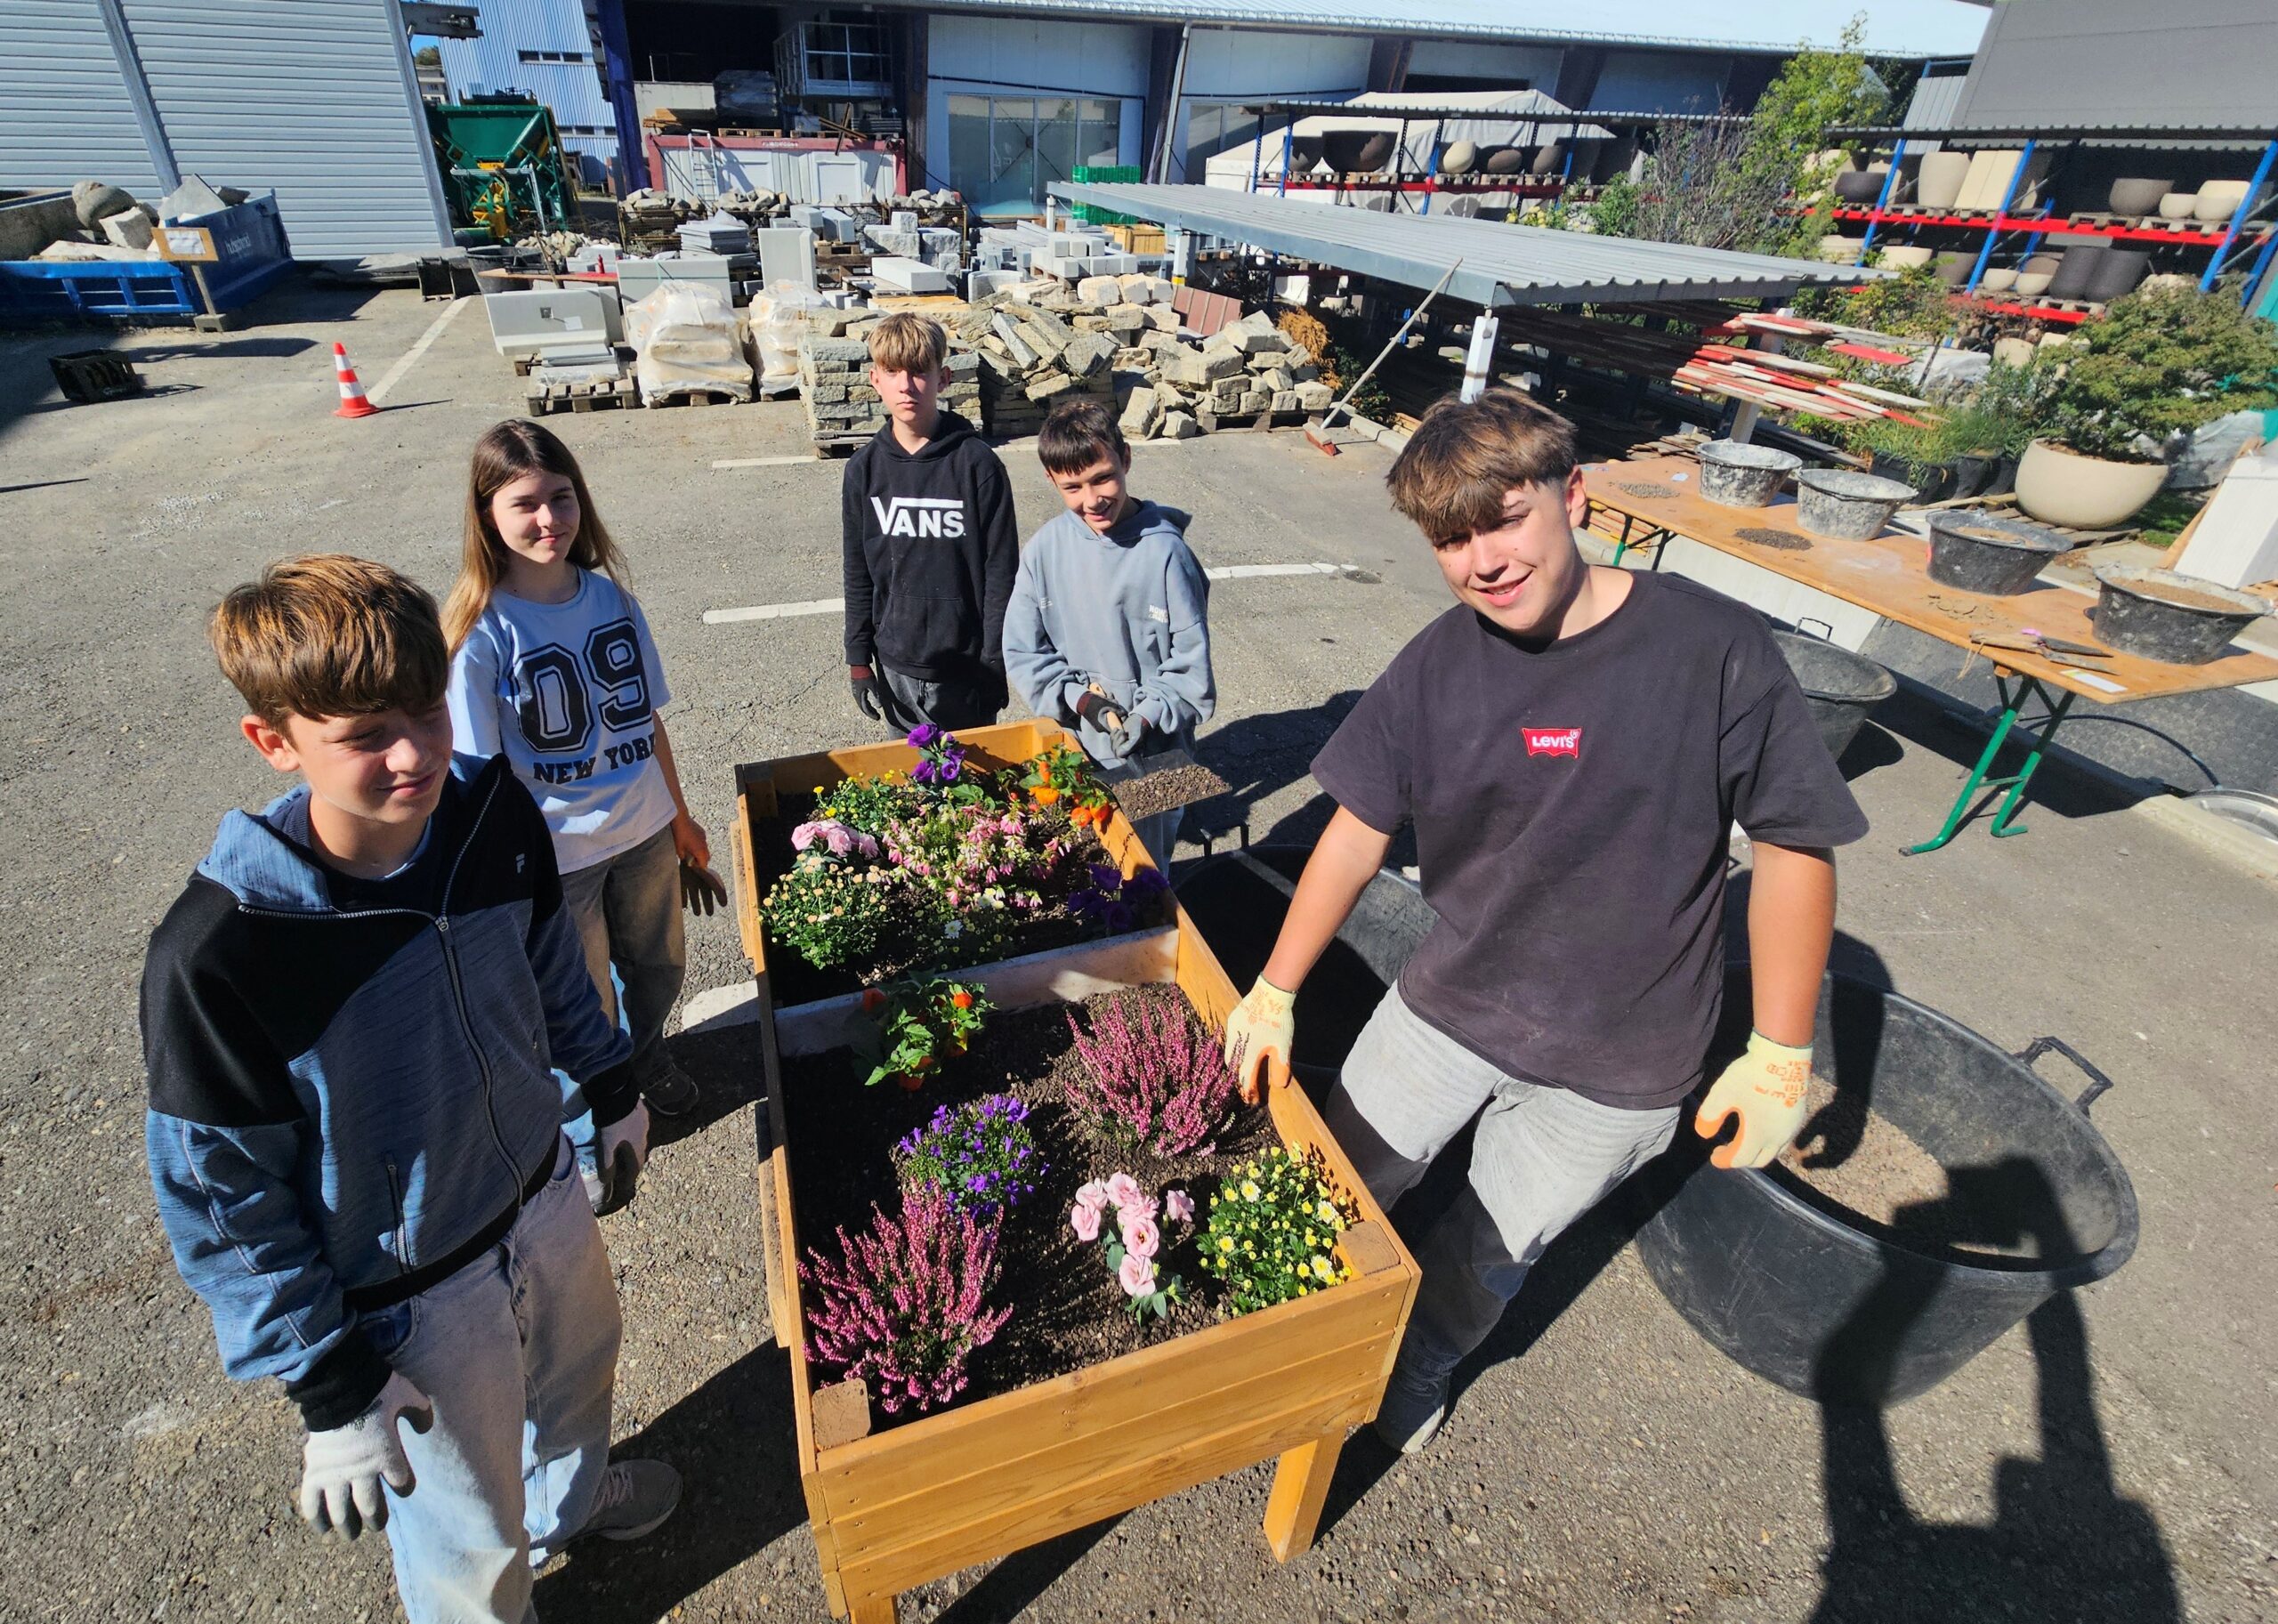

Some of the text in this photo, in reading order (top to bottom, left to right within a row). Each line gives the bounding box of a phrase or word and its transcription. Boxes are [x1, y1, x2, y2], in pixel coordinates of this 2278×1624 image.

[870, 497, 965, 537] VANS
[511, 617, 652, 754] 09
[533, 756, 597, 785] NEW
